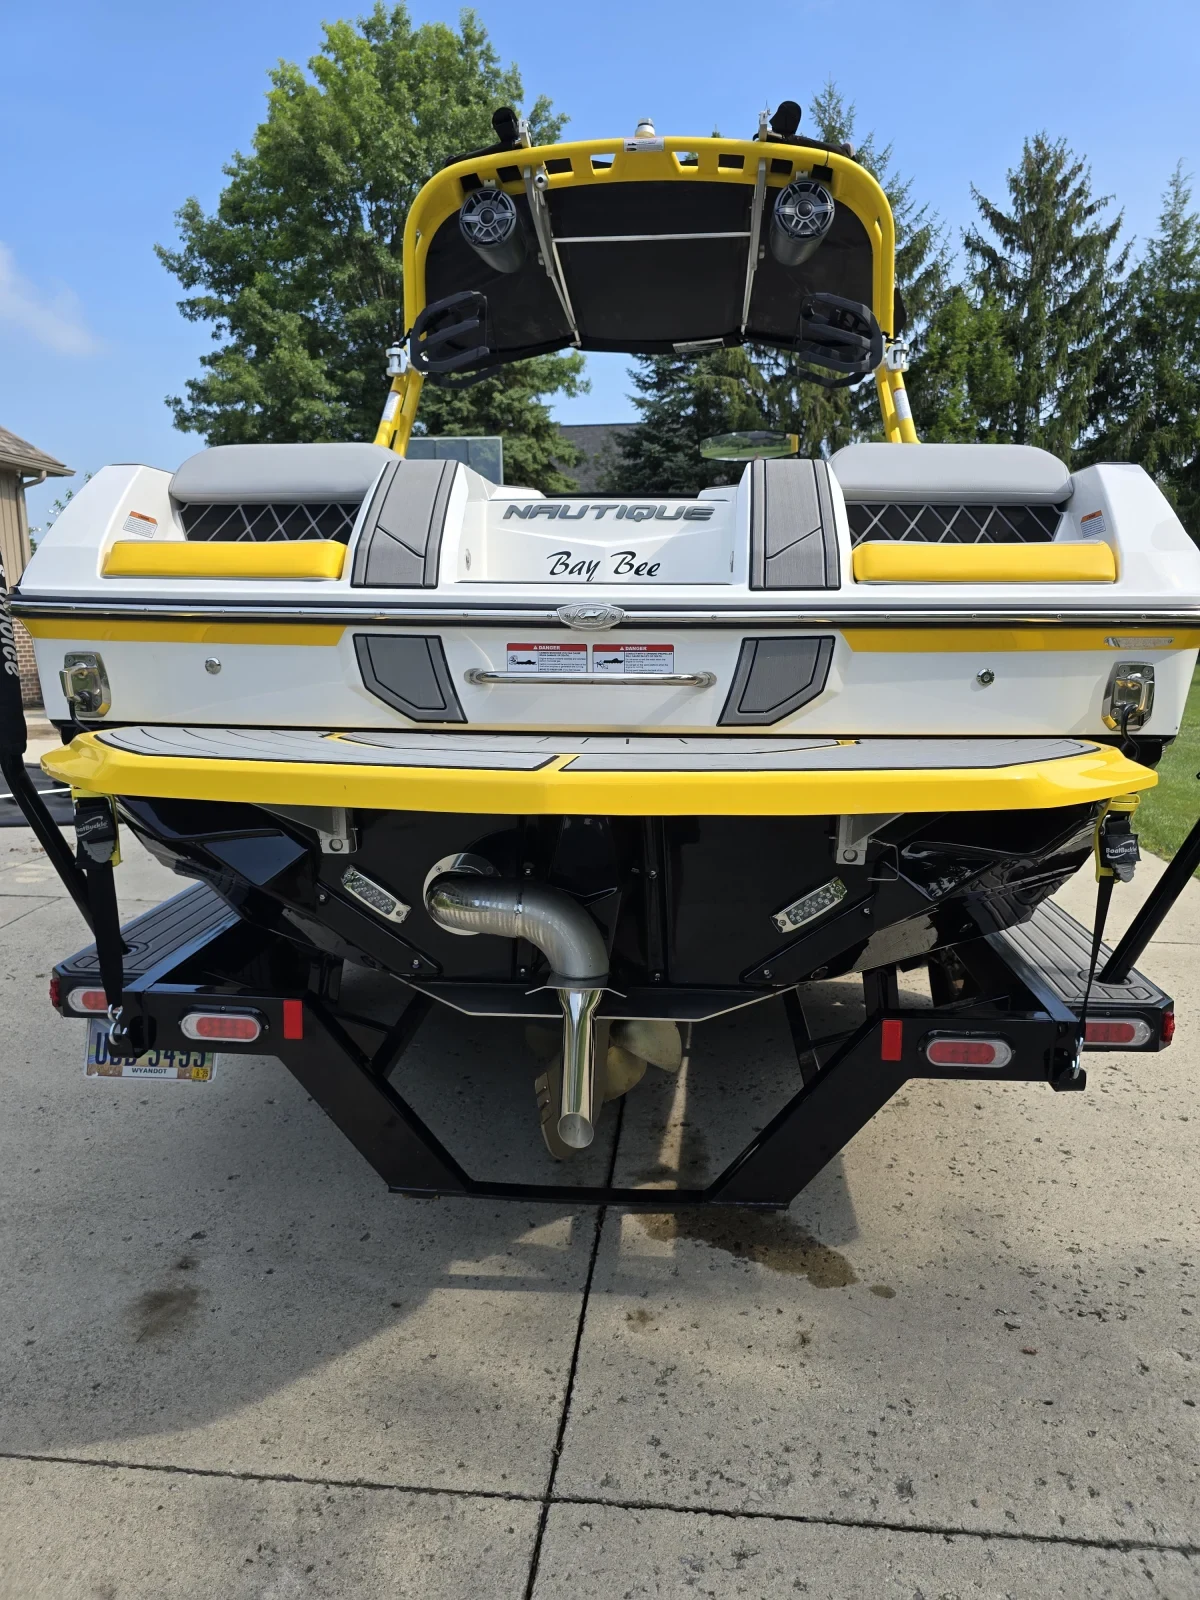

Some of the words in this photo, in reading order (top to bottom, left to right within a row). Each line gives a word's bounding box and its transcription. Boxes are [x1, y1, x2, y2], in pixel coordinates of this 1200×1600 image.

[502, 504, 716, 523] NAUTIQUE
[546, 550, 601, 582] Bay
[610, 550, 661, 577] Bee
[76, 820, 108, 832] oatBuckle
[131, 1067, 168, 1075] WYANDOT
